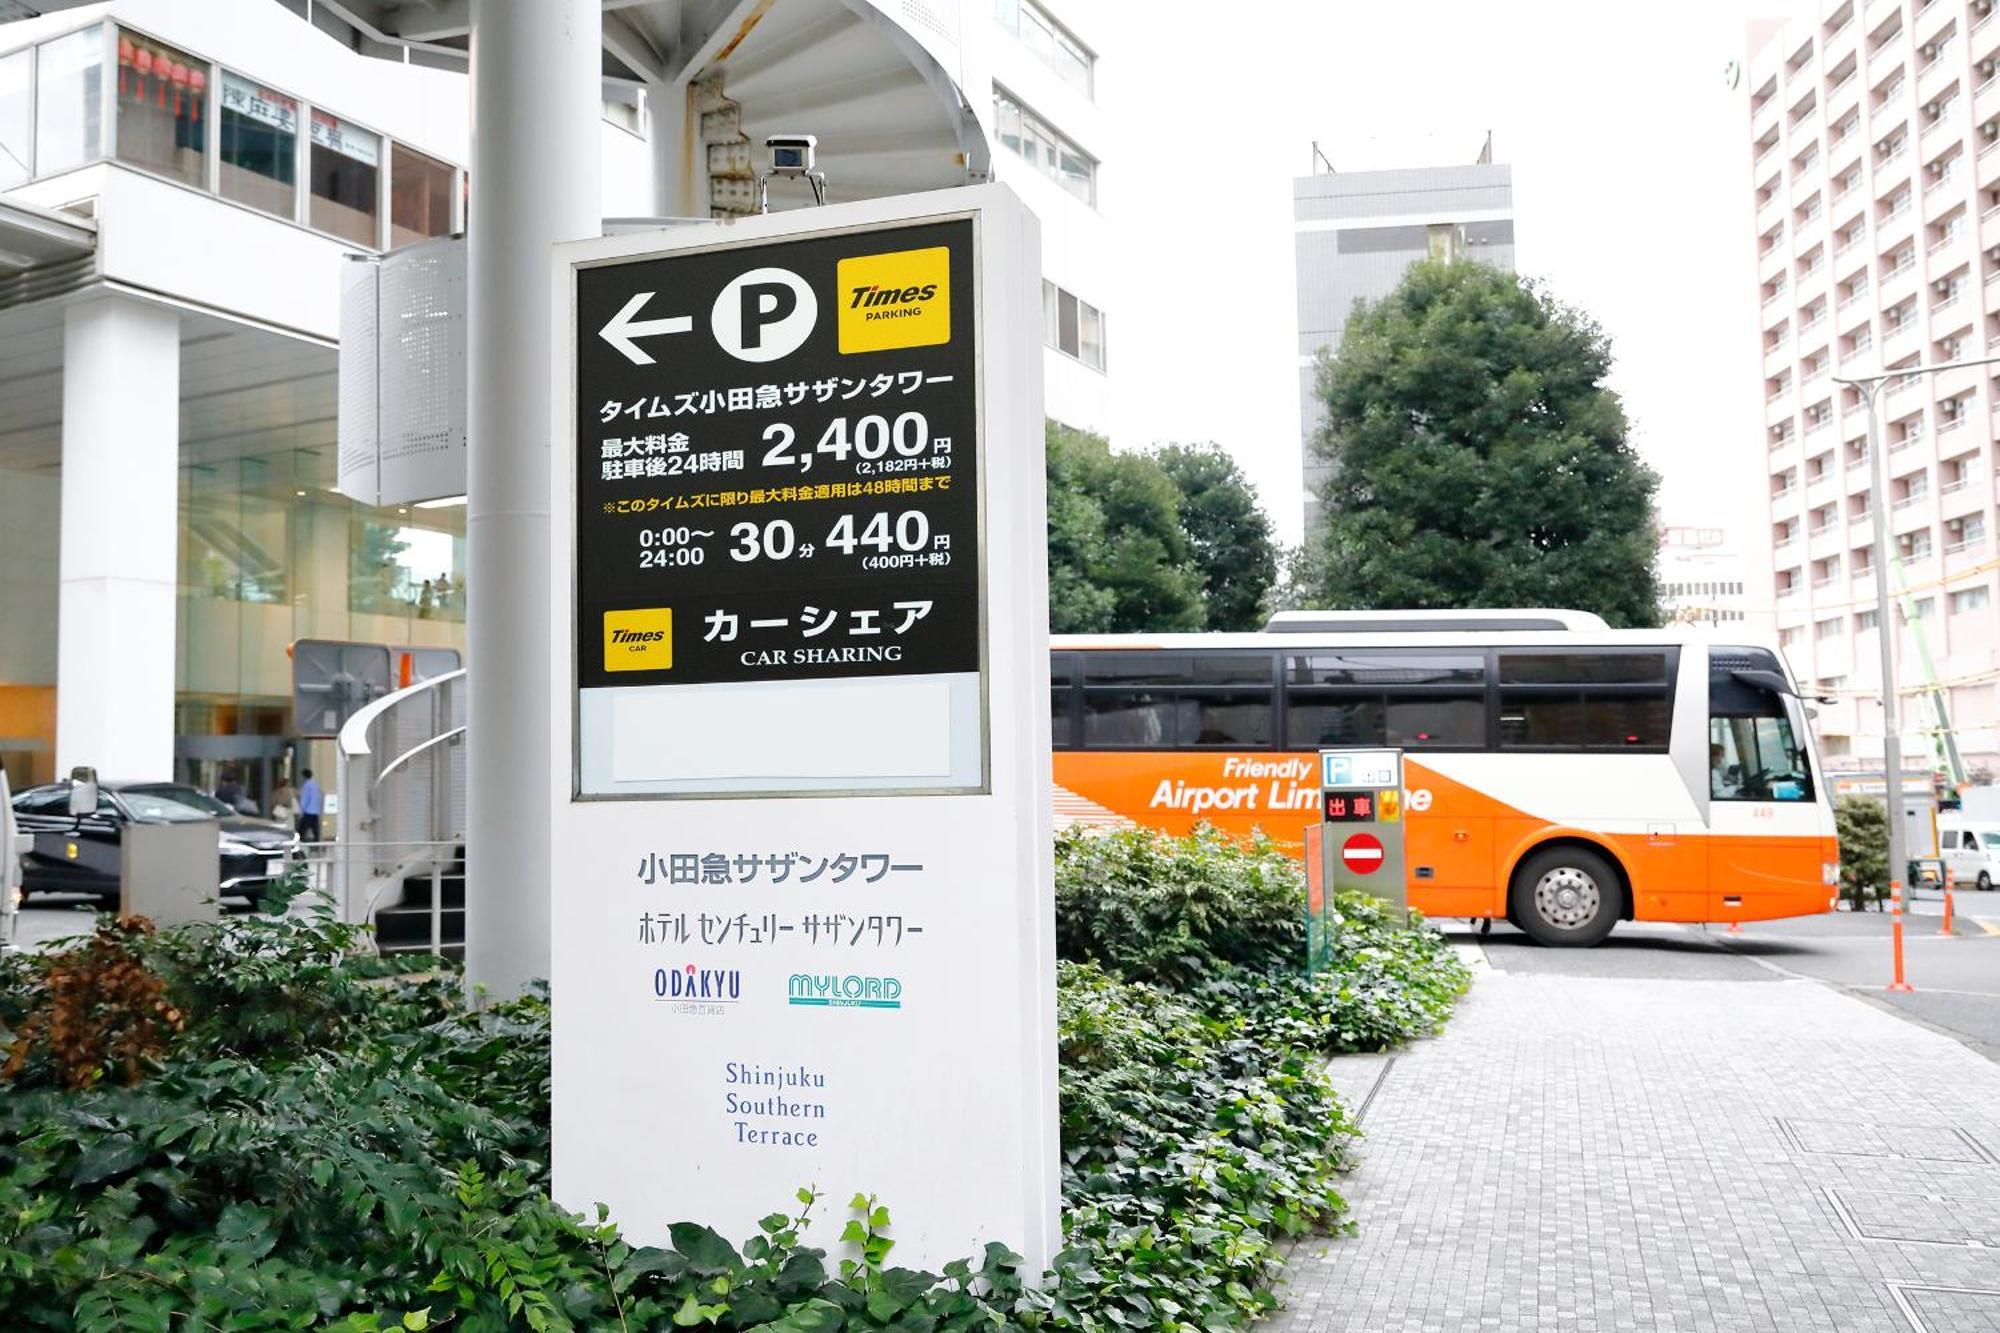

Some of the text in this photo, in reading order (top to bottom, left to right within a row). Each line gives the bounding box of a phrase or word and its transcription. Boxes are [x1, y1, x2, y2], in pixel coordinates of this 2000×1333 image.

[850, 283, 938, 309] Times
[739, 281, 798, 350] P
[864, 306, 922, 322] PARKING
[600, 370, 954, 424] タイムズ小田急サザンタワー
[600, 431, 690, 458] 最大料金
[600, 448, 745, 481] 駐車後24時間
[639, 547, 705, 569] 24:00
[703, 600, 934, 642] カーシェア
[611, 628, 665, 644] Times
[628, 644, 647, 652] CAR
[740, 645, 903, 666] CAR SHARING
[1223, 757, 1313, 781] Friendly
[1150, 779, 1260, 815] Airport
[1329, 797, 1371, 817] 出車
[637, 851, 924, 885] 小田急サザンタワー
[639, 911, 923, 947] ホテル センチュリー サザンタワー
[654, 964, 740, 999] ODAKYU
[788, 973, 902, 1000] MYLORD
[725, 1061, 825, 1091] Shinjuku
[726, 1092, 825, 1119] Southern
[734, 1121, 818, 1147] Terrace
